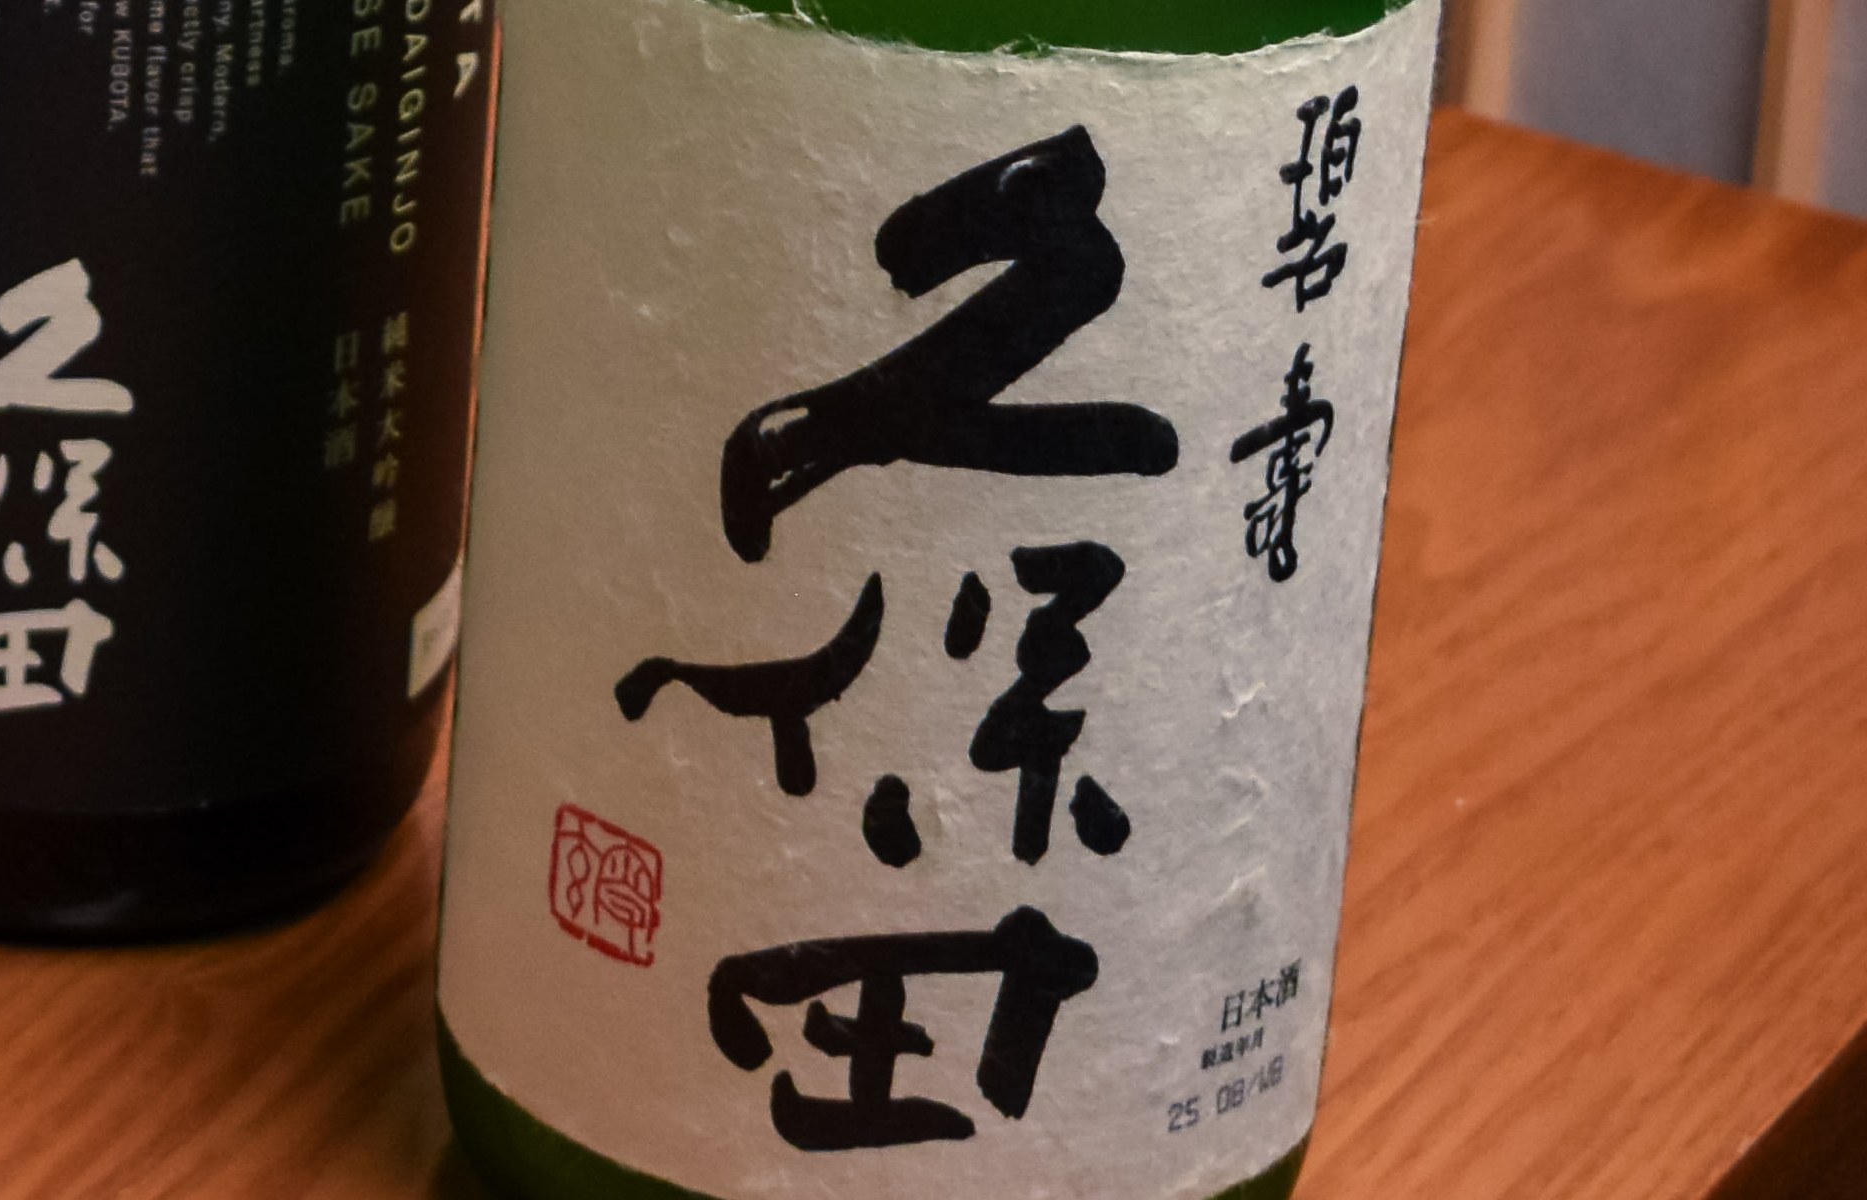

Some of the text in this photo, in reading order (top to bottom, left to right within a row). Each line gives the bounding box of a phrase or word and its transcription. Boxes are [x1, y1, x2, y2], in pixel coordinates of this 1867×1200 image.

[77, 1, 99, 35] for
[107, 29, 134, 131] KUBOTA.
[143, 45, 168, 115] flavor
[175, 61, 197, 124] crisp
[139, 126, 162, 177] that
[338, 82, 378, 226] SAKE
[616, 126, 1178, 1150] 久保田
